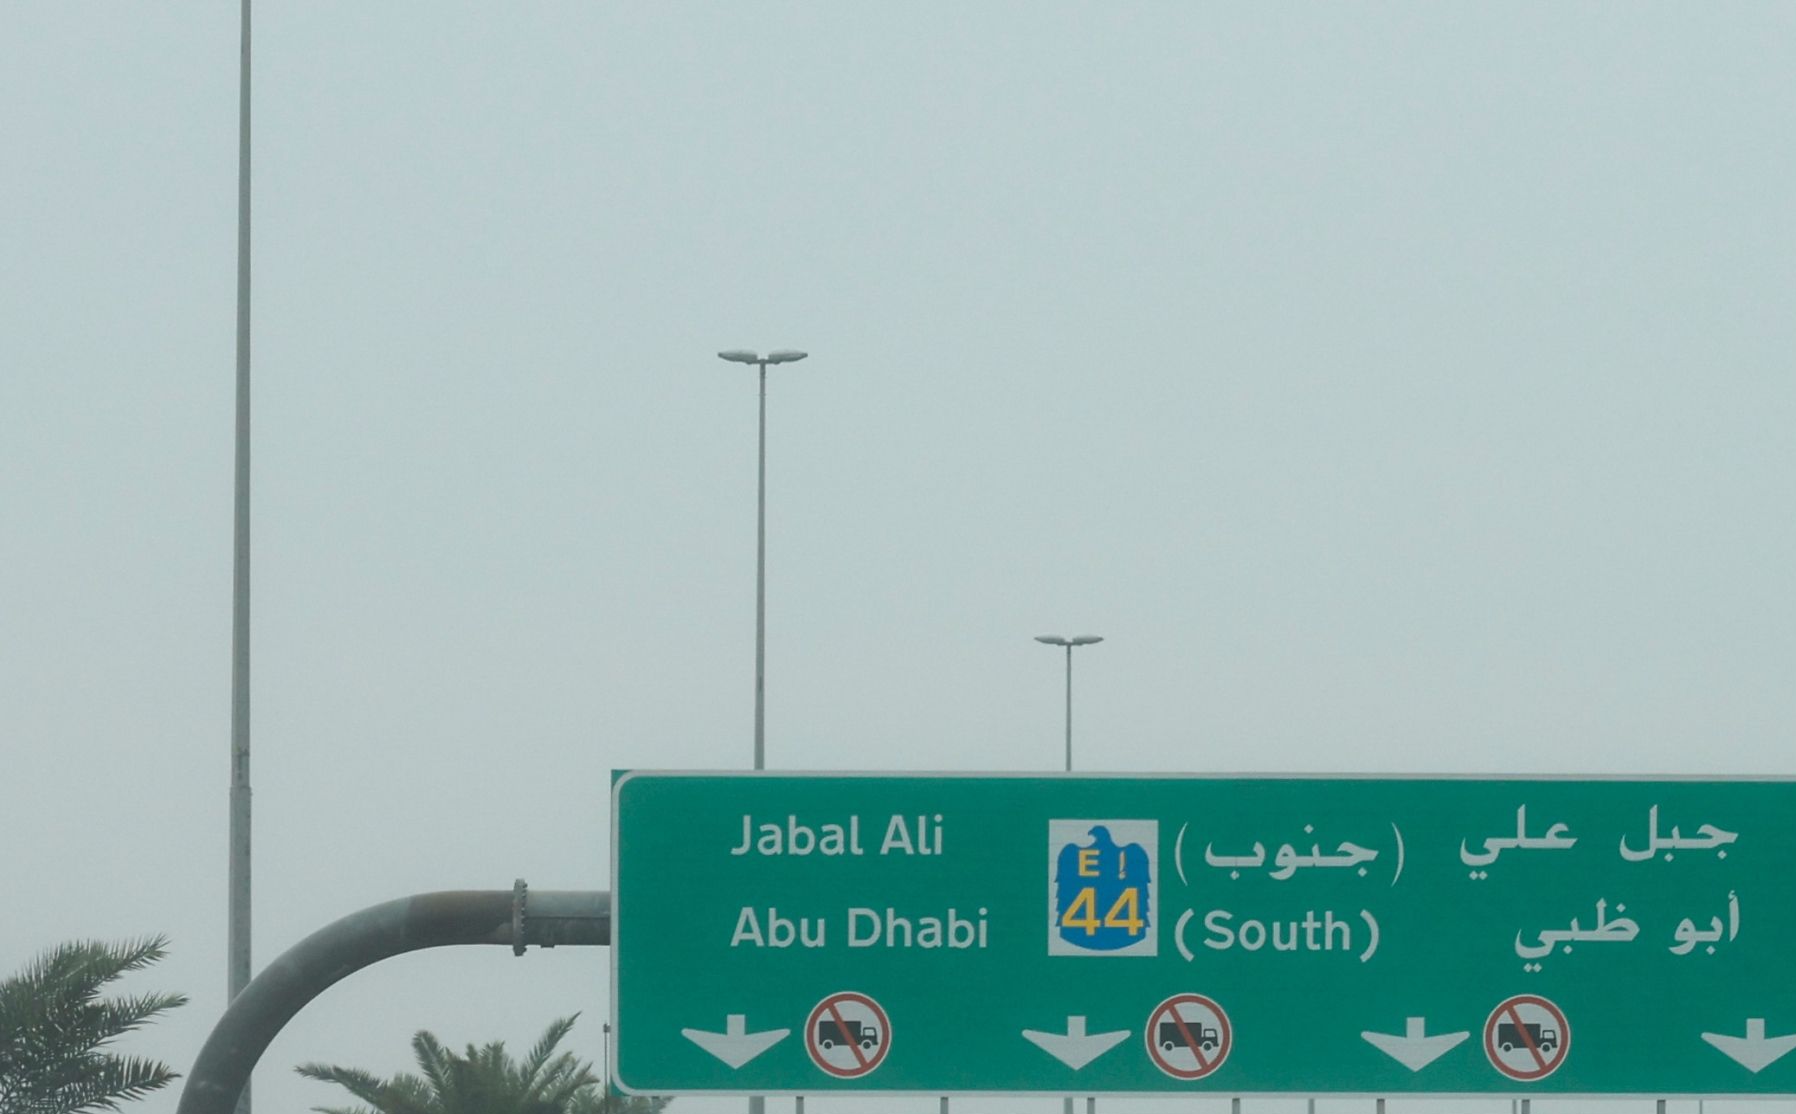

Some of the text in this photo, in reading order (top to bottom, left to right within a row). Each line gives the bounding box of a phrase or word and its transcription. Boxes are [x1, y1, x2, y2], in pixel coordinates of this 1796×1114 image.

[731, 815, 944, 855] Jabal Ali
[1461, 804, 1738, 880] جبل علي
[1078, 850, 1099, 876] E
[731, 908, 988, 948] Abu Dhabi
[1061, 887, 1144, 936] 44
[1174, 909, 1379, 962] (South)
[1515, 890, 1740, 972] أبو ظبي
